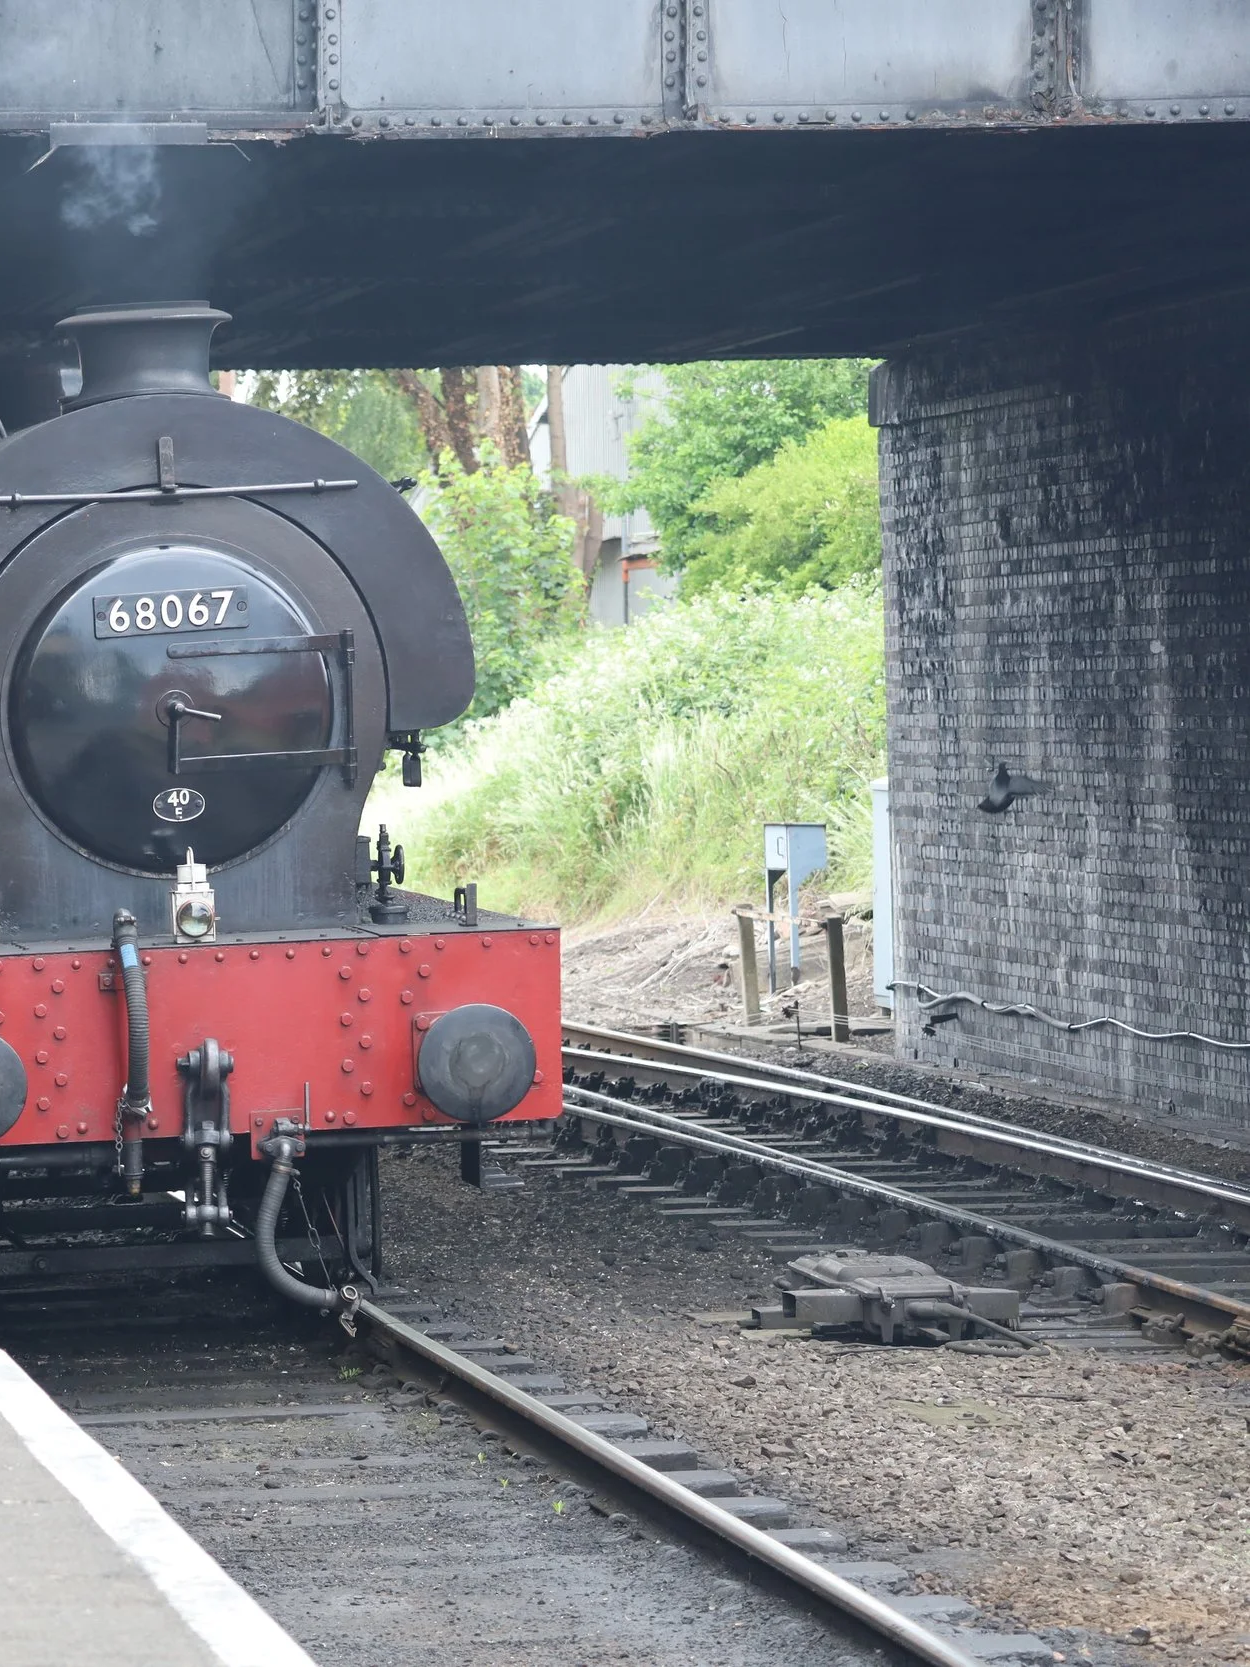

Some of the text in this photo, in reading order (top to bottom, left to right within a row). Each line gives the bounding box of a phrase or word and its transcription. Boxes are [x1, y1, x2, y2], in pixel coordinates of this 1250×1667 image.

[109, 590, 234, 632] 68067
[167, 789, 190, 807] 40
[175, 807, 183, 819] E
